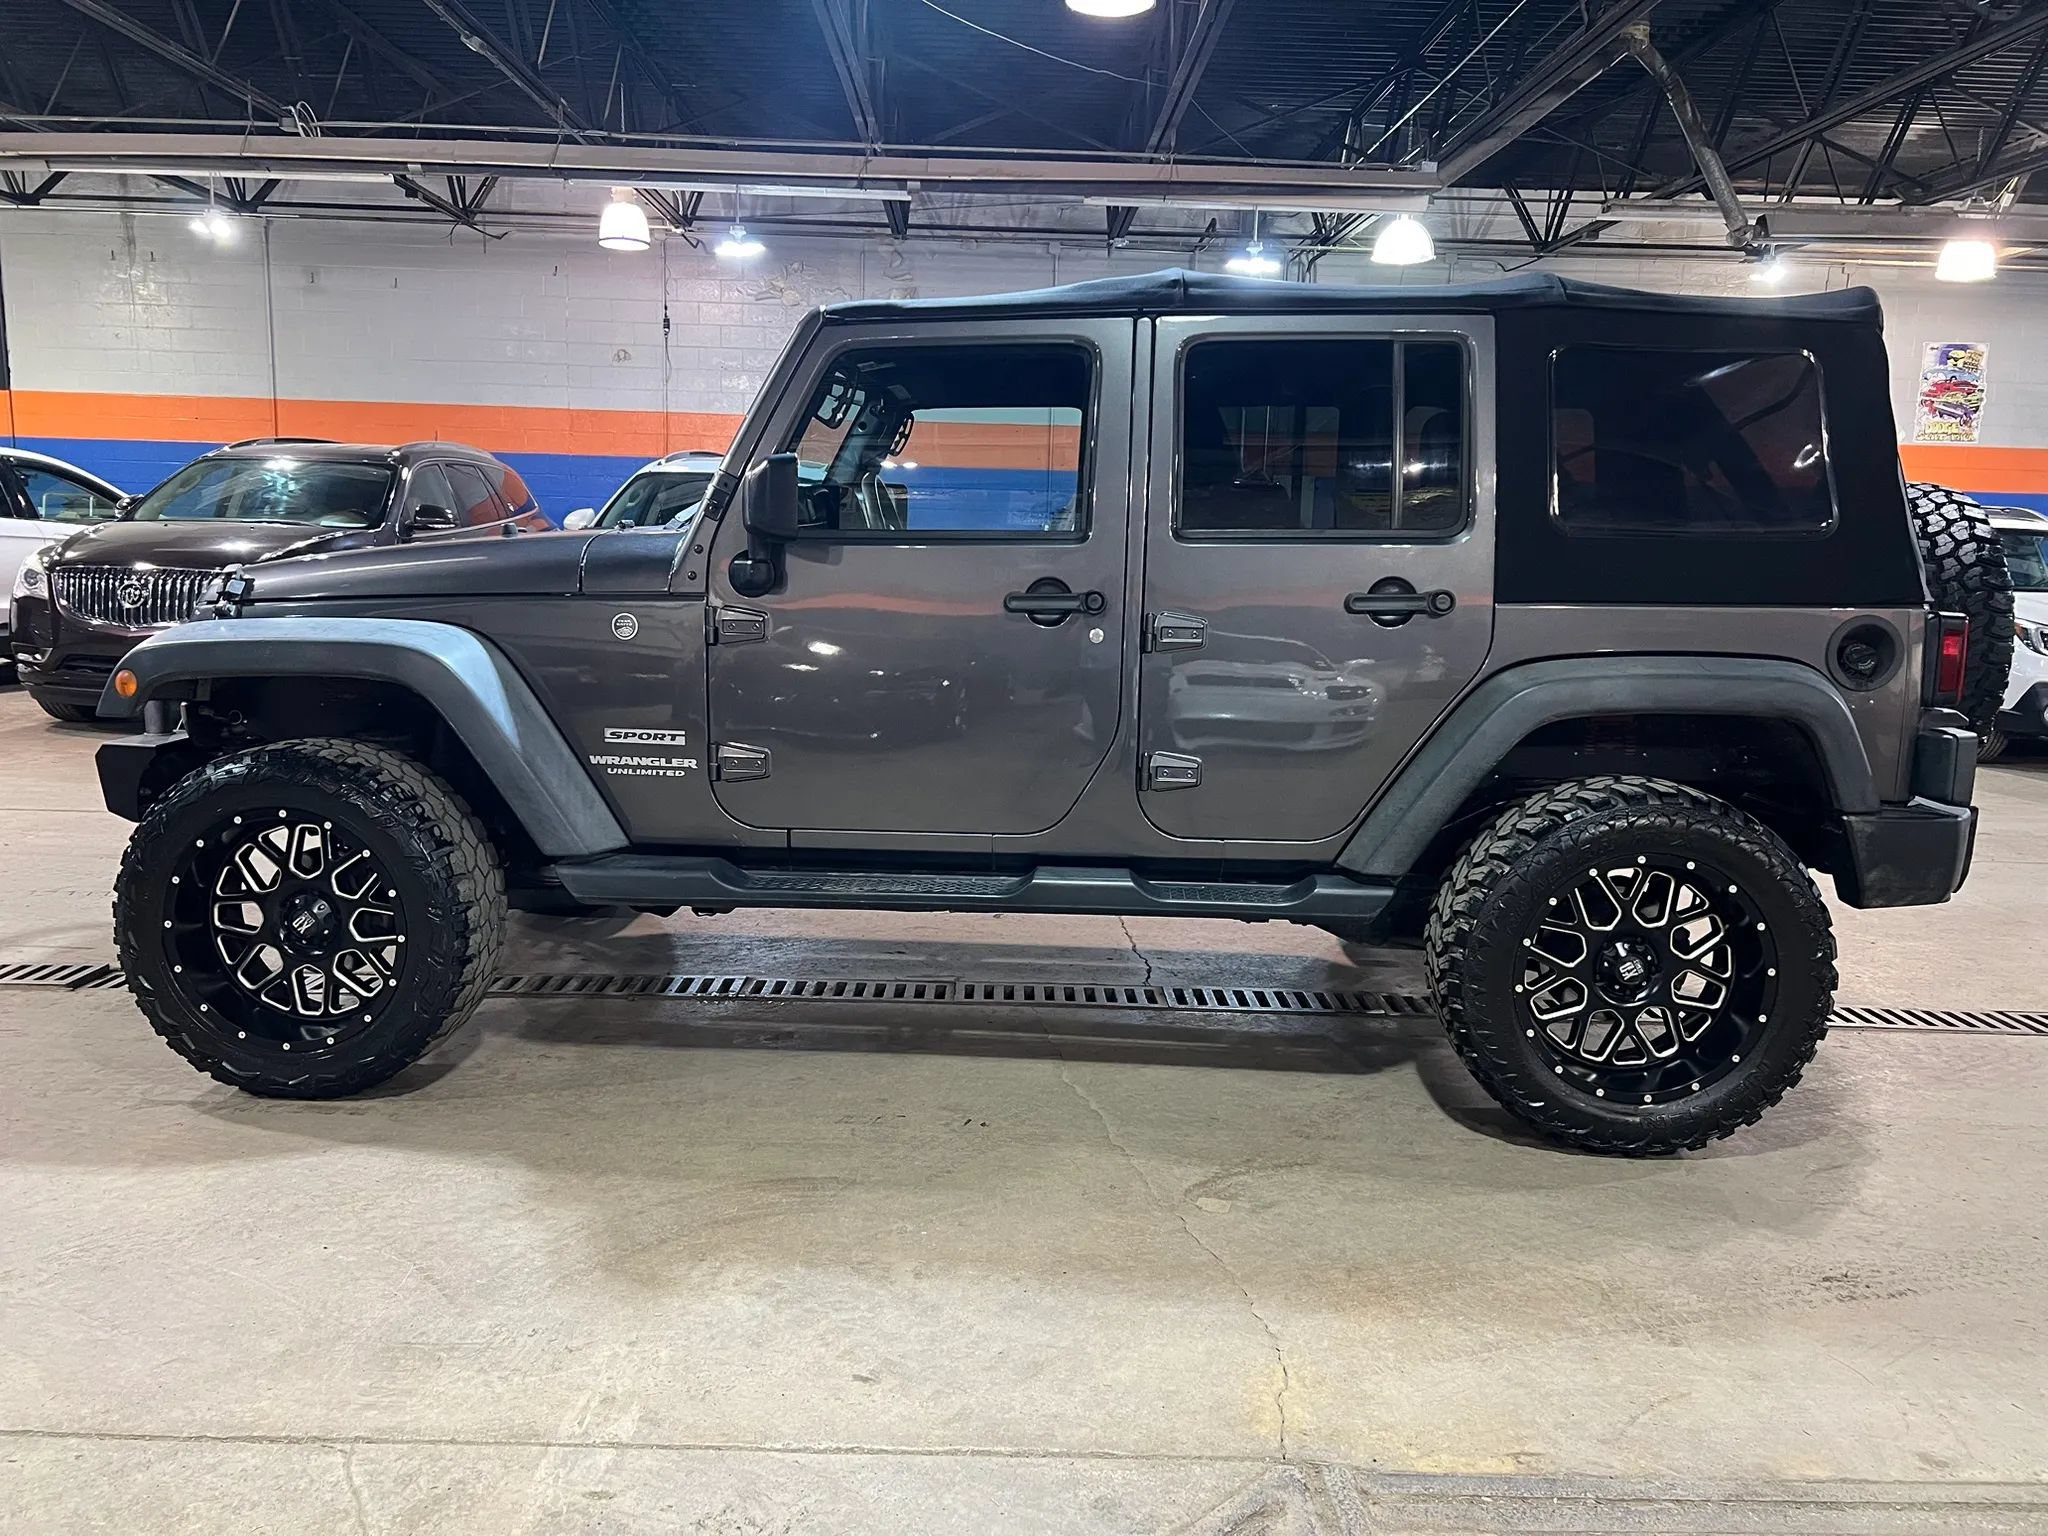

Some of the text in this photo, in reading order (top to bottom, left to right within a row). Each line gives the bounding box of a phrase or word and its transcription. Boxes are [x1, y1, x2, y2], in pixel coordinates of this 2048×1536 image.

[609, 731, 679, 742] SPORT
[589, 755, 698, 769] WRANGLER
[607, 767, 686, 777] UNLIMITED
